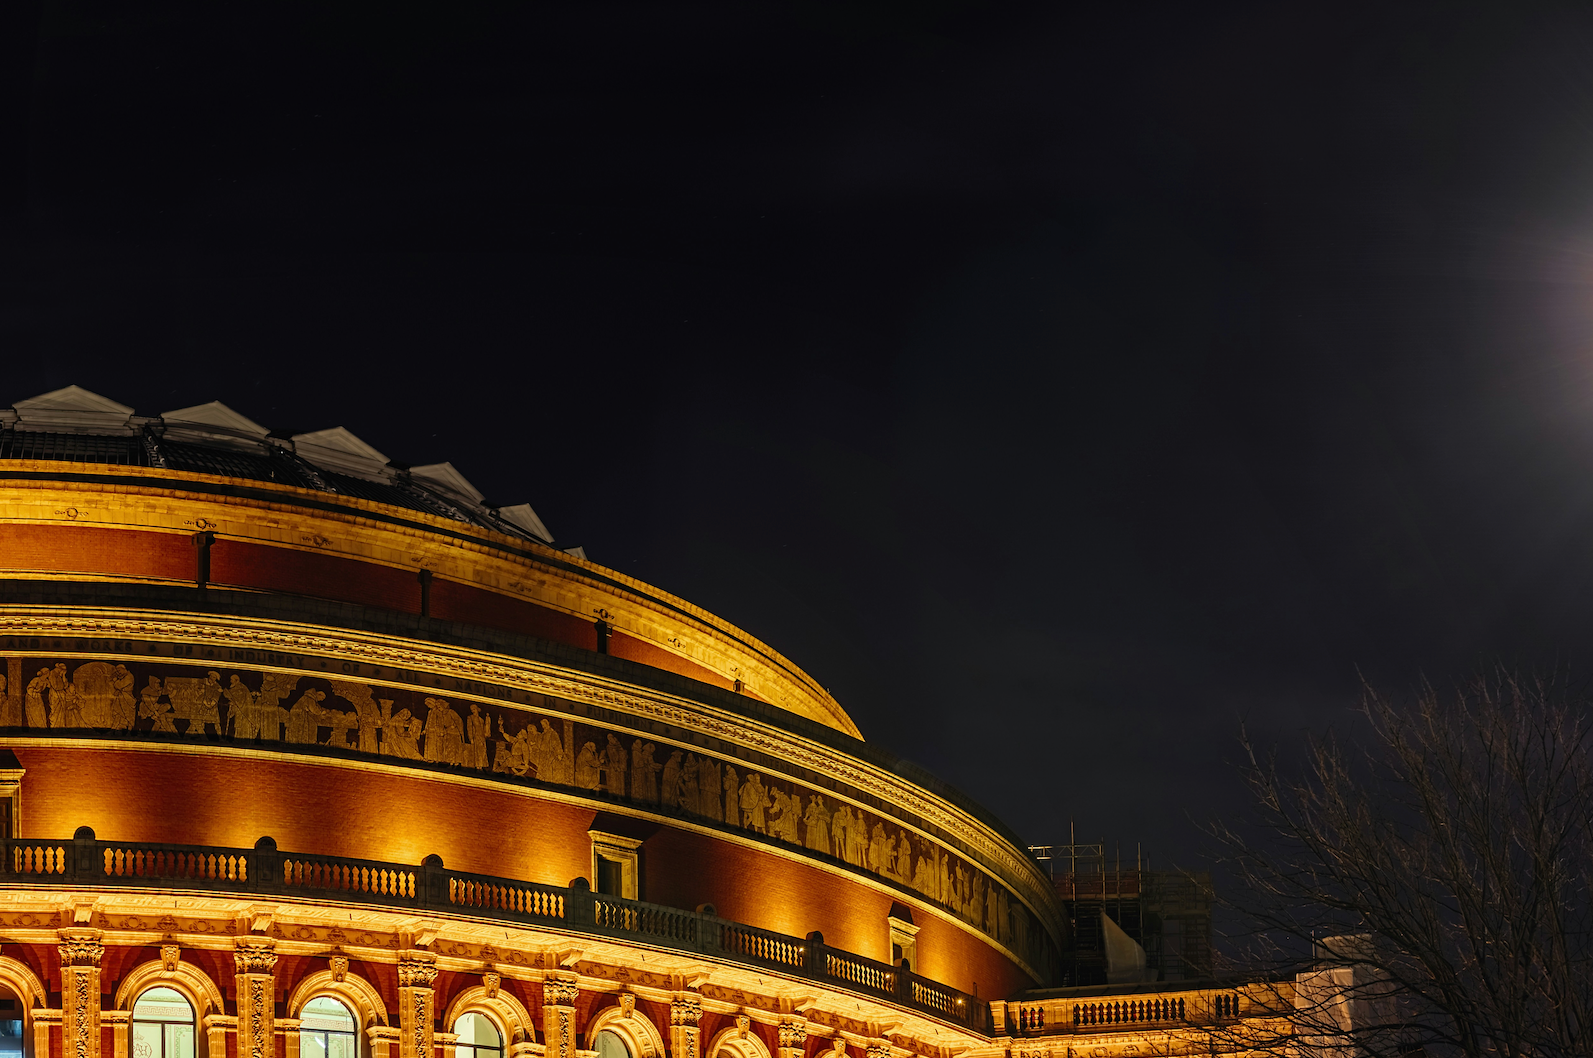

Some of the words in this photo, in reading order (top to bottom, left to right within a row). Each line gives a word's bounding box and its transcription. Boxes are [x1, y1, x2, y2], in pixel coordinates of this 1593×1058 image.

[8, 638, 40, 649] AND
[75, 639, 133, 652] WORKS
[229, 650, 305, 668] INDUSTRY
[342, 663, 360, 674] OF
[396, 671, 421, 683] ALL
[456, 680, 513, 699] NATIONS
[543, 696, 557, 708] IN
